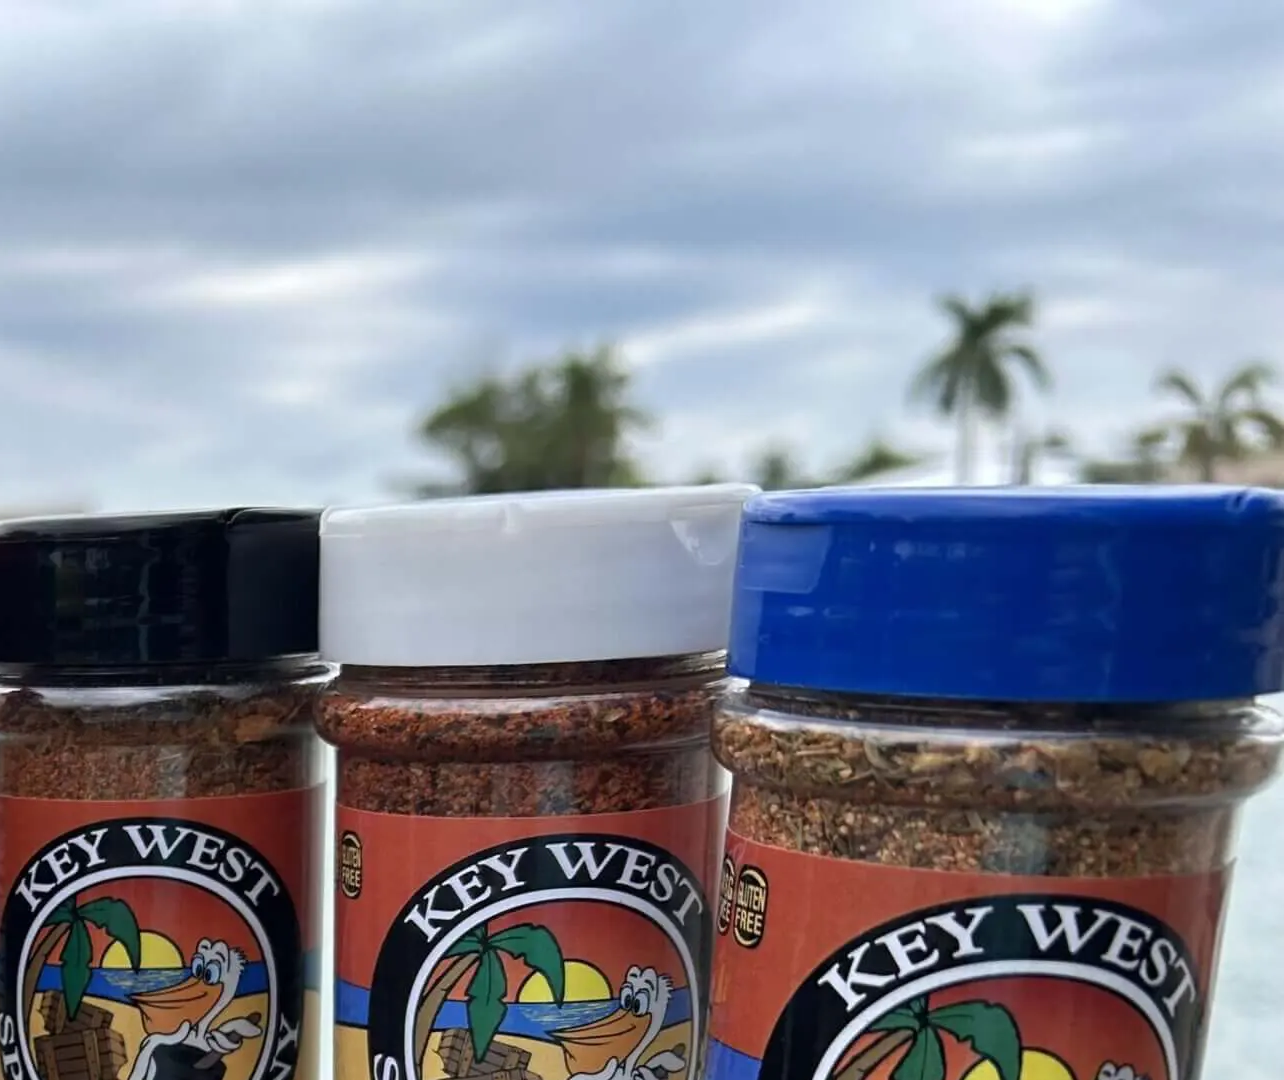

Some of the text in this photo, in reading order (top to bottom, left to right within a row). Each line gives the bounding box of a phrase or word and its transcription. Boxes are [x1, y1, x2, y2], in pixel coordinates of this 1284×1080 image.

[16, 824, 280, 912] KEY WEST
[404, 847, 536, 944] KEY
[546, 841, 704, 929] WEST
[738, 880, 766, 913] GLUTEN
[735, 907, 763, 935] FREE
[817, 903, 1198, 1015] KEY WEST
